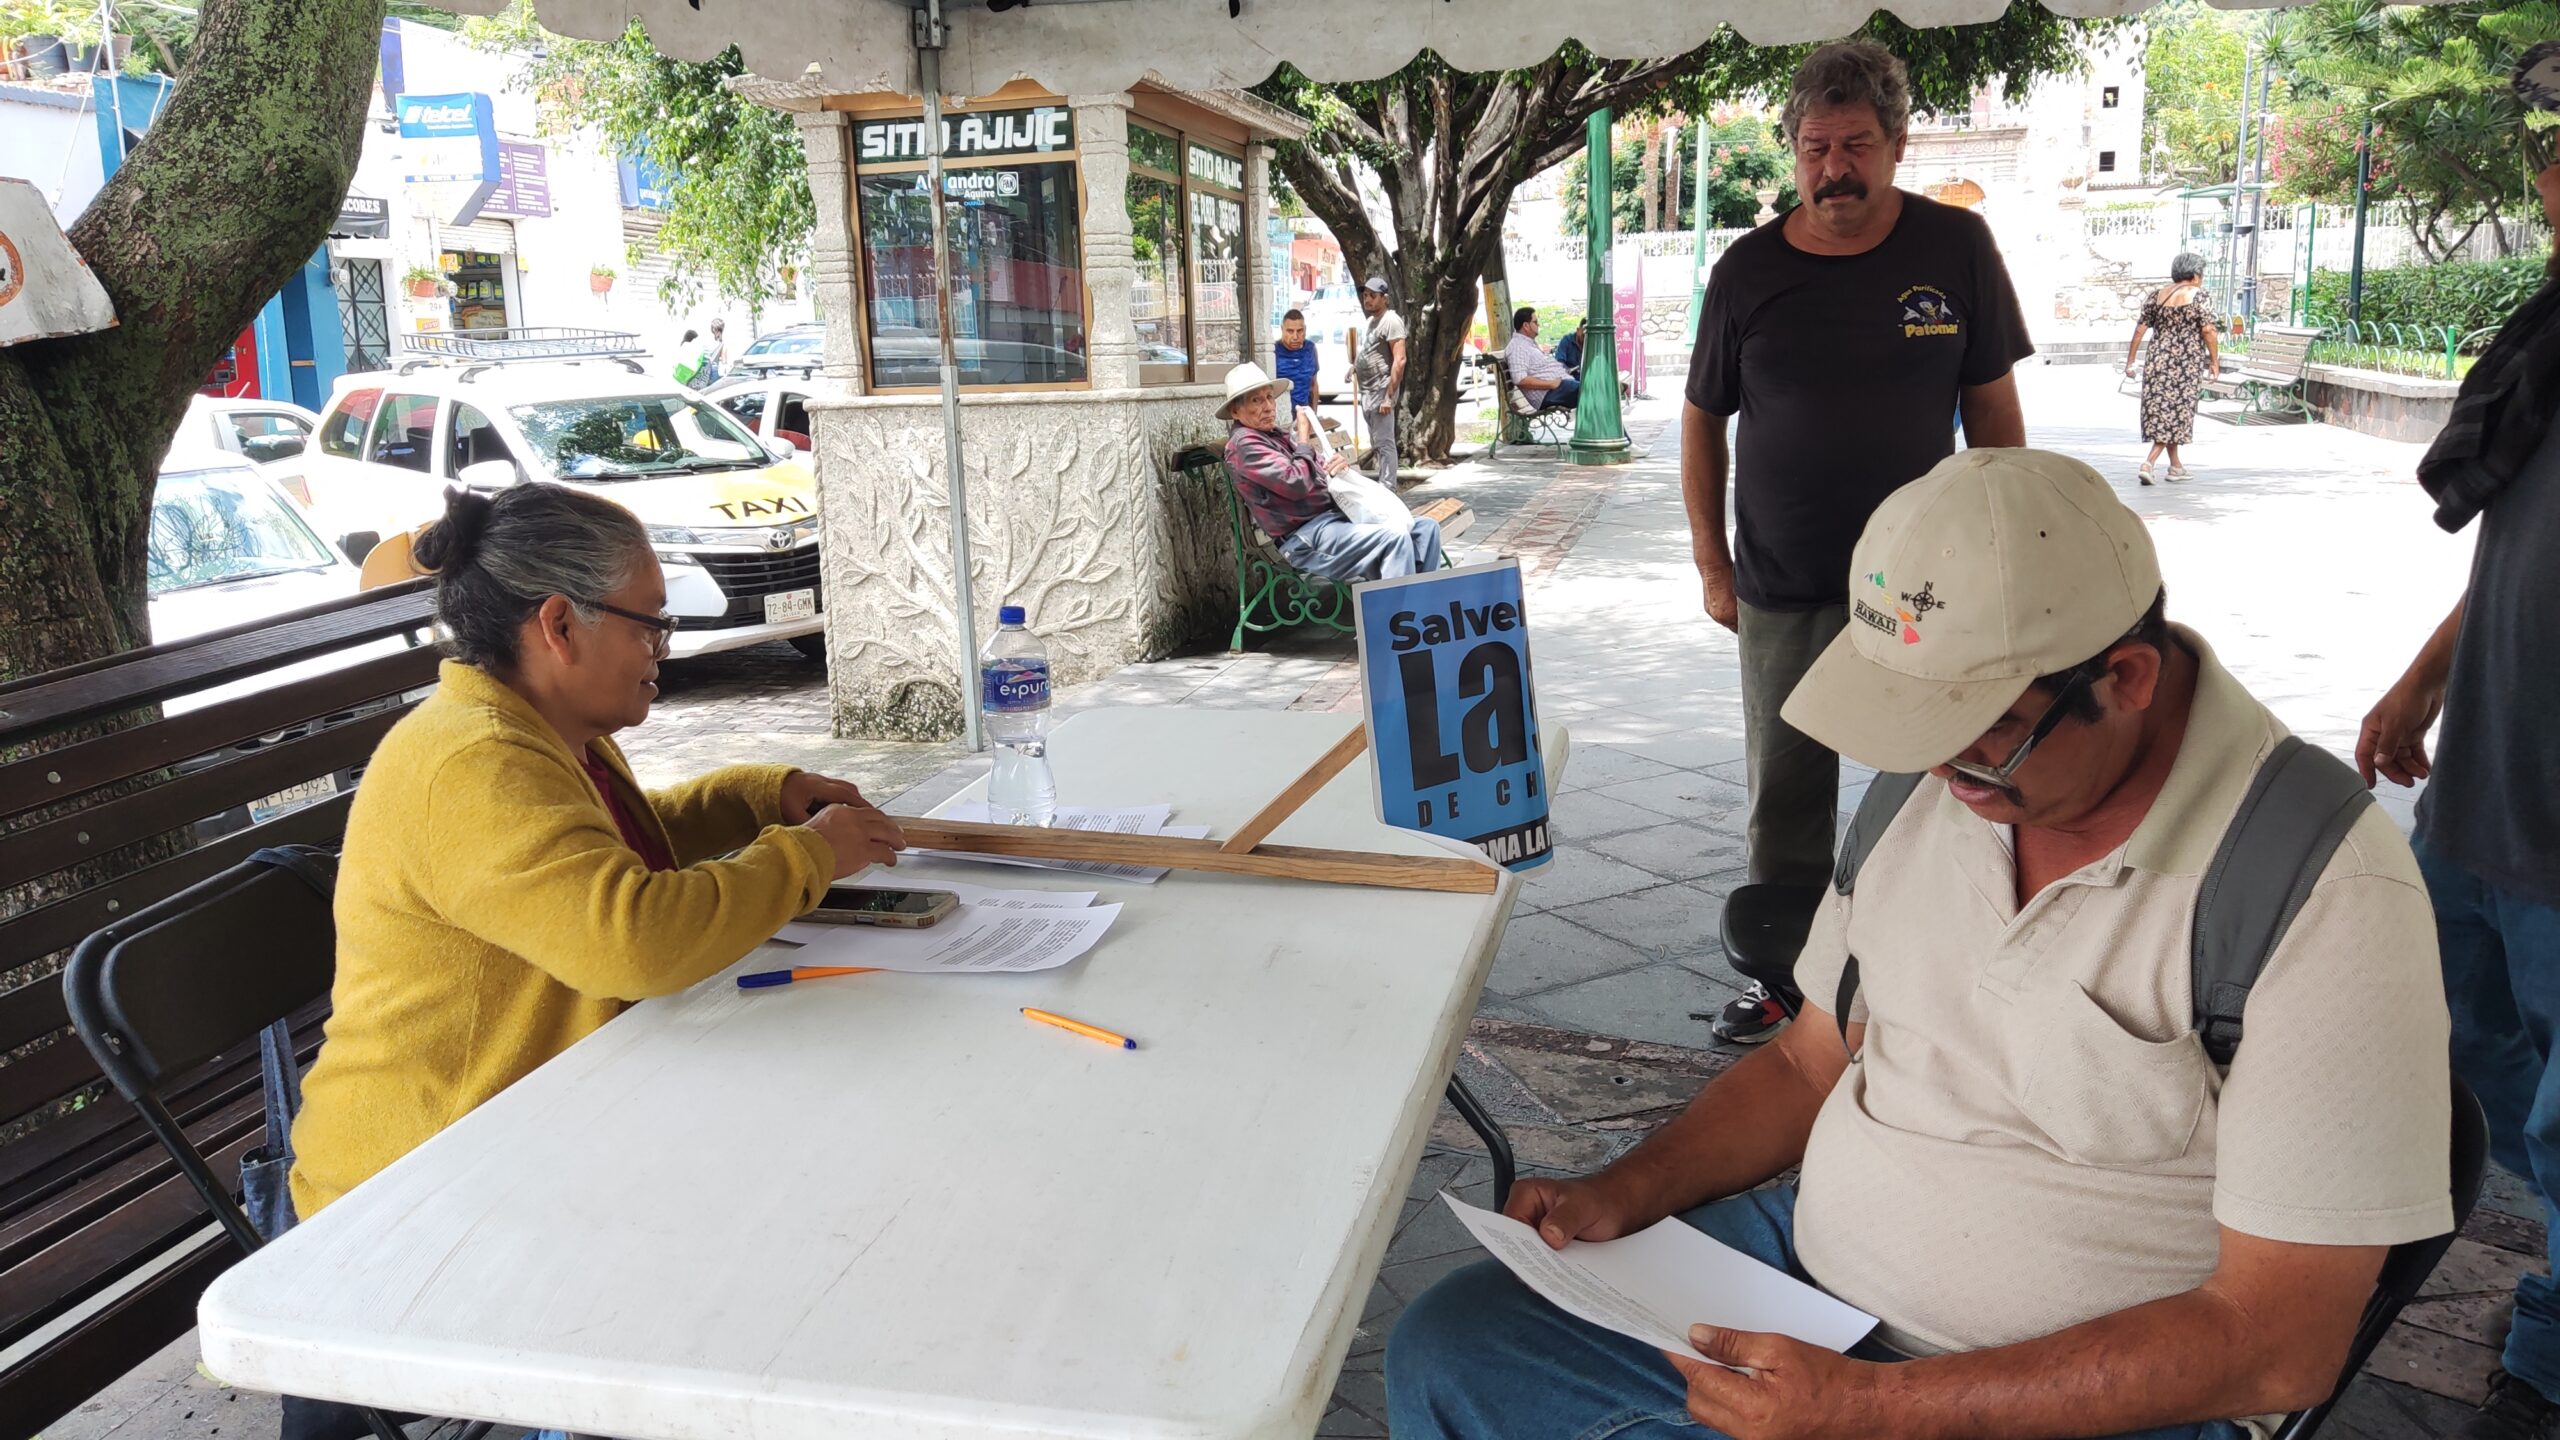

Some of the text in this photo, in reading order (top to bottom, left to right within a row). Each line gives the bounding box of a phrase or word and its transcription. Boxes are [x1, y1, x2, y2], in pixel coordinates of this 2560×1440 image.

[422, 103, 473, 124] telcel
[959, 111, 1068, 152] AJIJIC
[1189, 146, 1214, 180] SITIO
[915, 172, 995, 192] Aljandro
[963, 189, 995, 200] Aguirre
[709, 496, 809, 520] TAXI
[1924, 581, 1934, 591] N
[1901, 592, 1946, 609] W E
[1855, 602, 1897, 632] HAWAII
[1398, 640, 1541, 793] La
